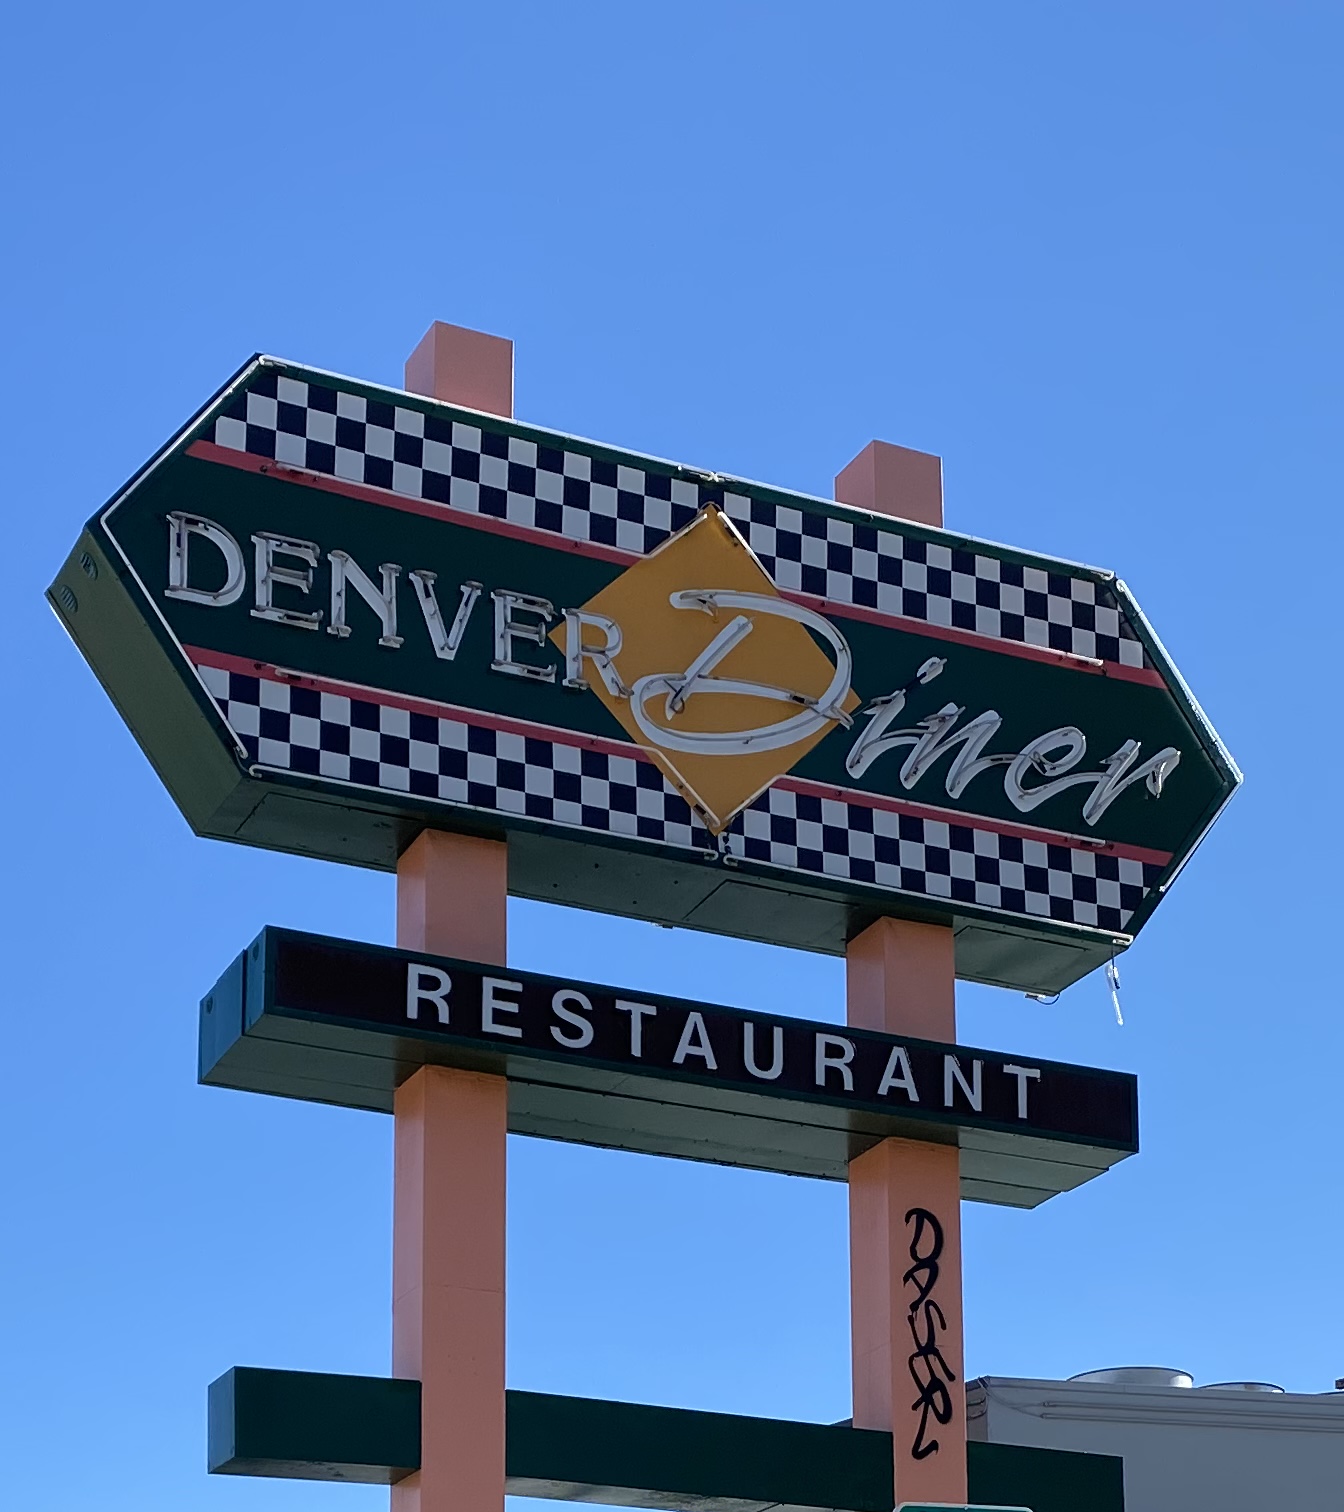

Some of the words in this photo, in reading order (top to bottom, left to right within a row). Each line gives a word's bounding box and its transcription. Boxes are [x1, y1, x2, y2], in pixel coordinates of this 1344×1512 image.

[164, 509, 633, 698] DENVER
[630, 588, 1182, 827] Diner
[406, 962, 1042, 1120] RESTAURANT
